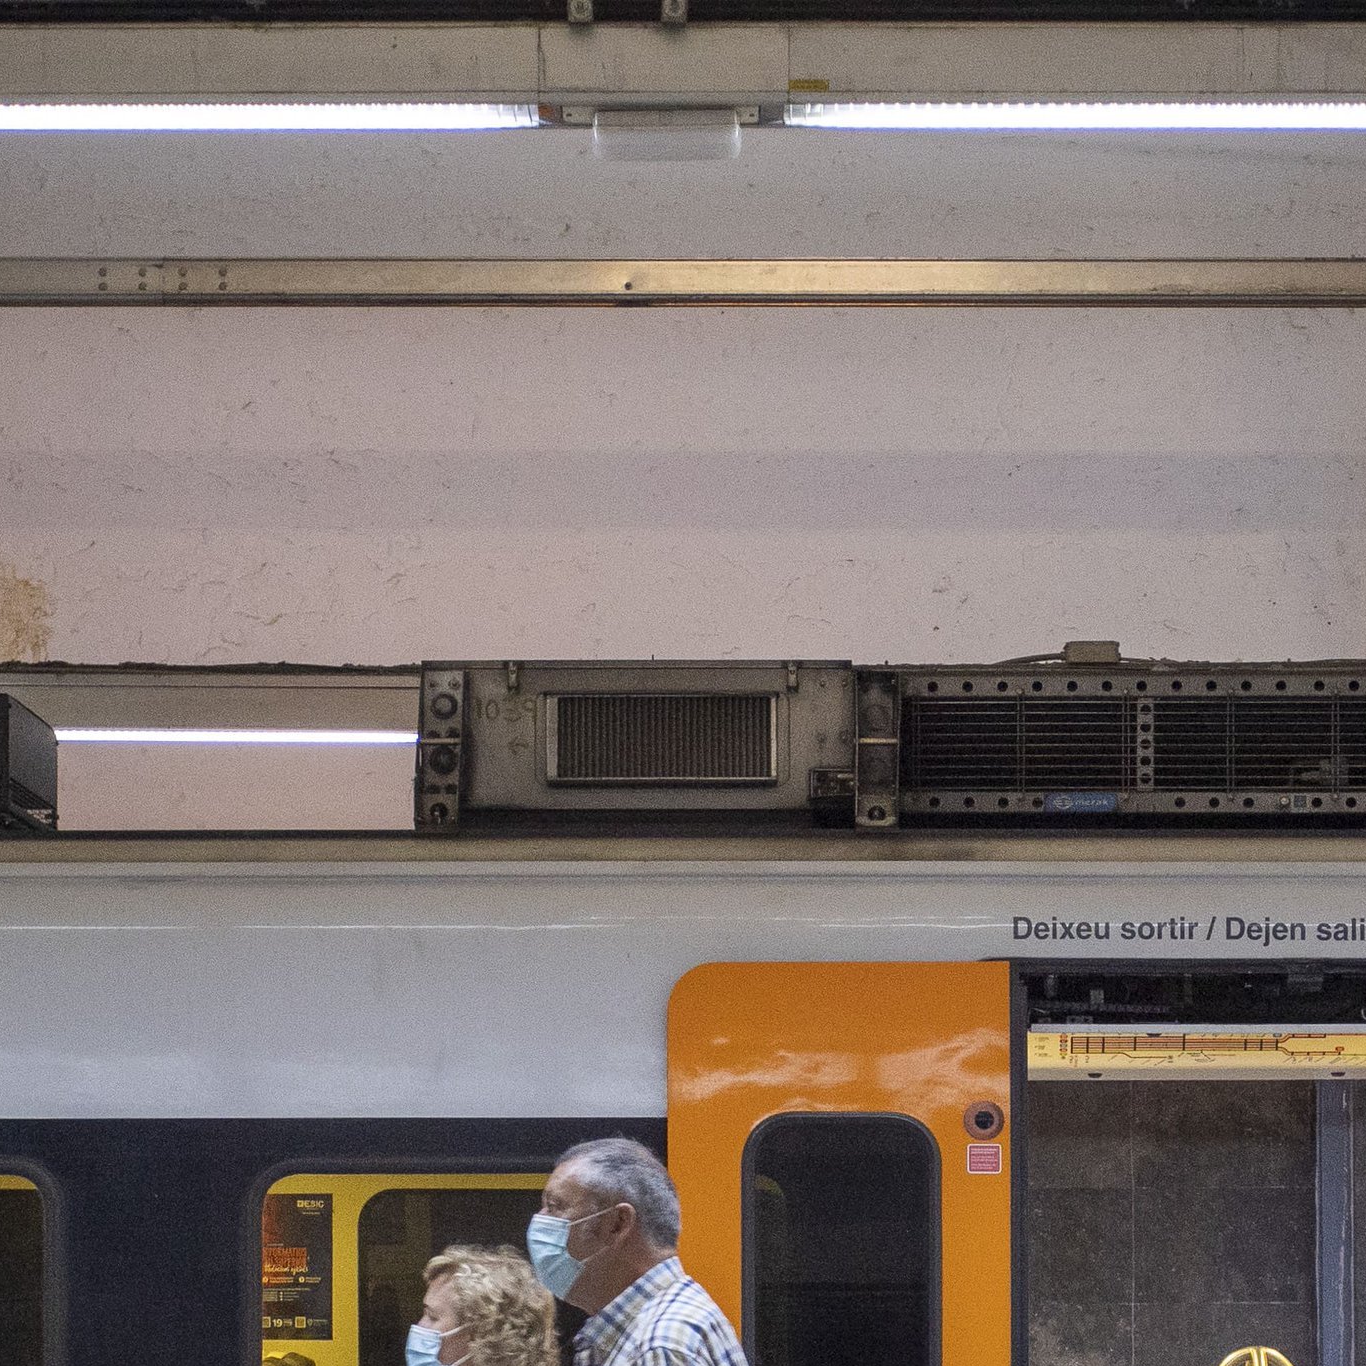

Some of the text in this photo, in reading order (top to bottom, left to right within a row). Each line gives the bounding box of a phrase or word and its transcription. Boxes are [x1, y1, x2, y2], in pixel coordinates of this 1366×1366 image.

[1012, 916, 1110, 940] Deixeu
[1120, 916, 1199, 940] sortir
[1206, 916, 1217, 941] /
[1225, 916, 1306, 947] Dejen
